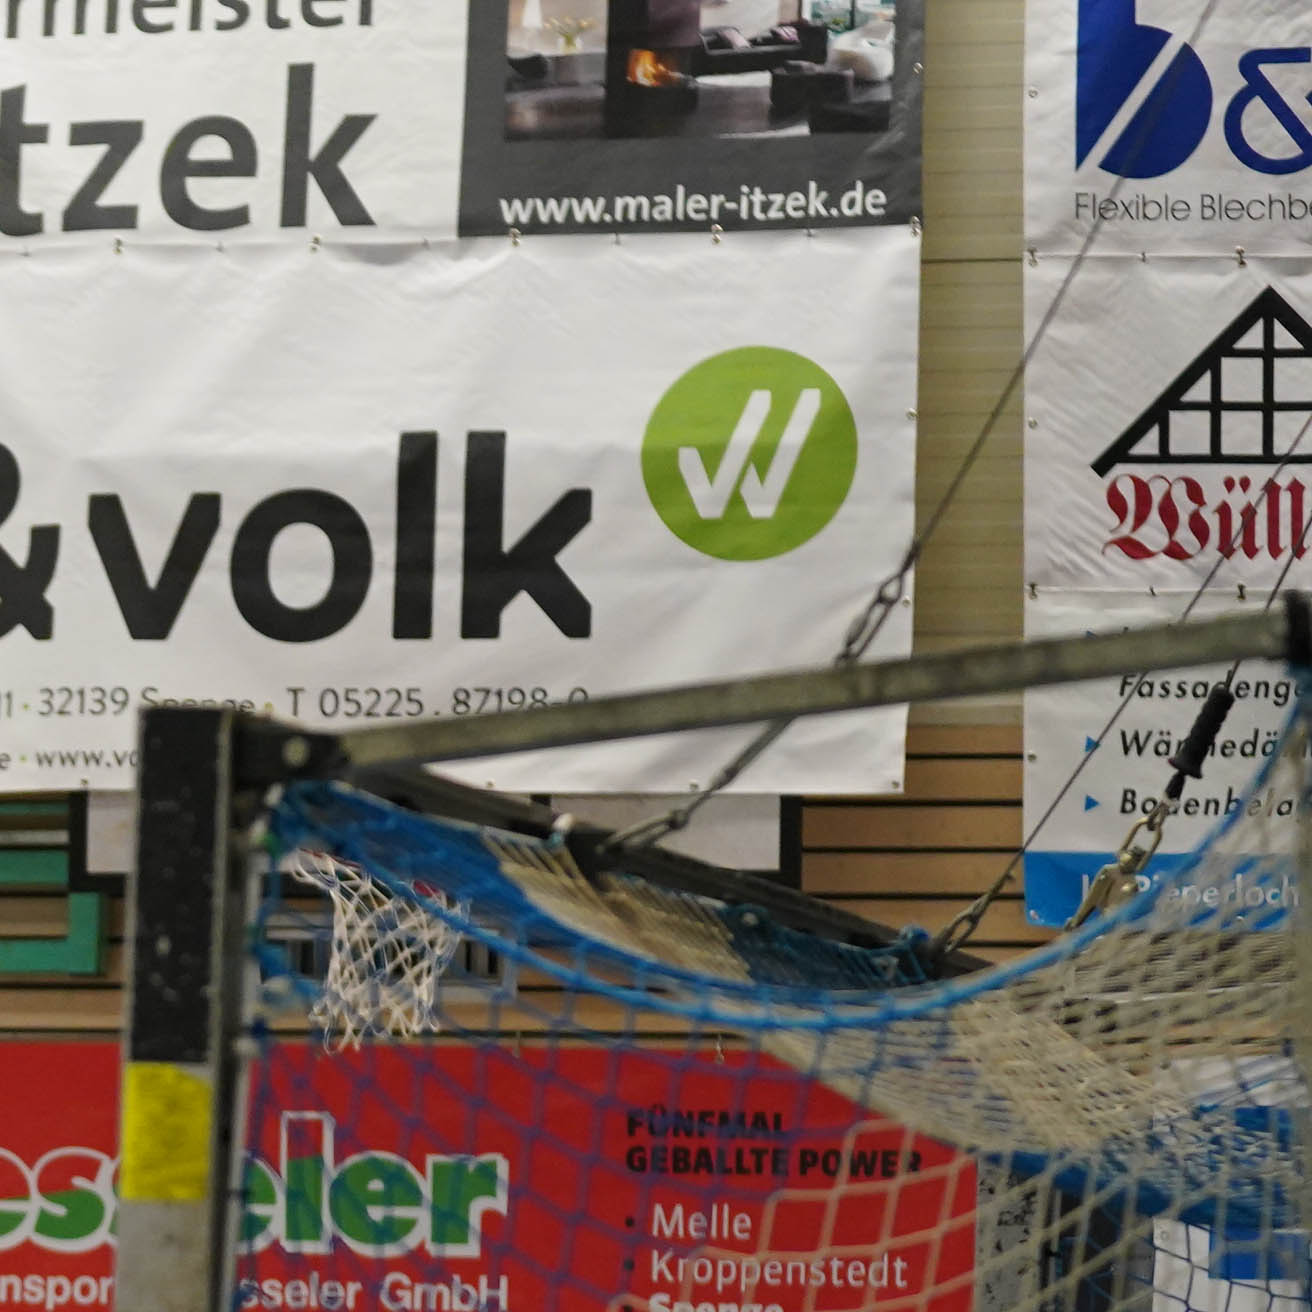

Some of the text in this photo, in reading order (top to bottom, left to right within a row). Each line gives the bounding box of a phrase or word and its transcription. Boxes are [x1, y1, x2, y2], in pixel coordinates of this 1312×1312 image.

[498, 182, 887, 226] www.maler-itzek.de
[1075, 192, 1192, 222] Flexible
[1102, 472, 1312, 561] Wüll
[37, 686, 131, 718] 32139
[287, 686, 304, 718] T
[319, 686, 424, 718] 05225
[1119, 669, 1301, 707] Fassadeng
[1120, 727, 1280, 758] Wäedä
[1120, 786, 1295, 817] Boenbela
[625, 1104, 784, 1139] FÜNFMAL
[625, 1145, 922, 1179] GEBALLTE POWER
[651, 1202, 752, 1240] Melle
[650, 1250, 909, 1290] Kroppenstedt
[238, 1271, 363, 1312] sseler
